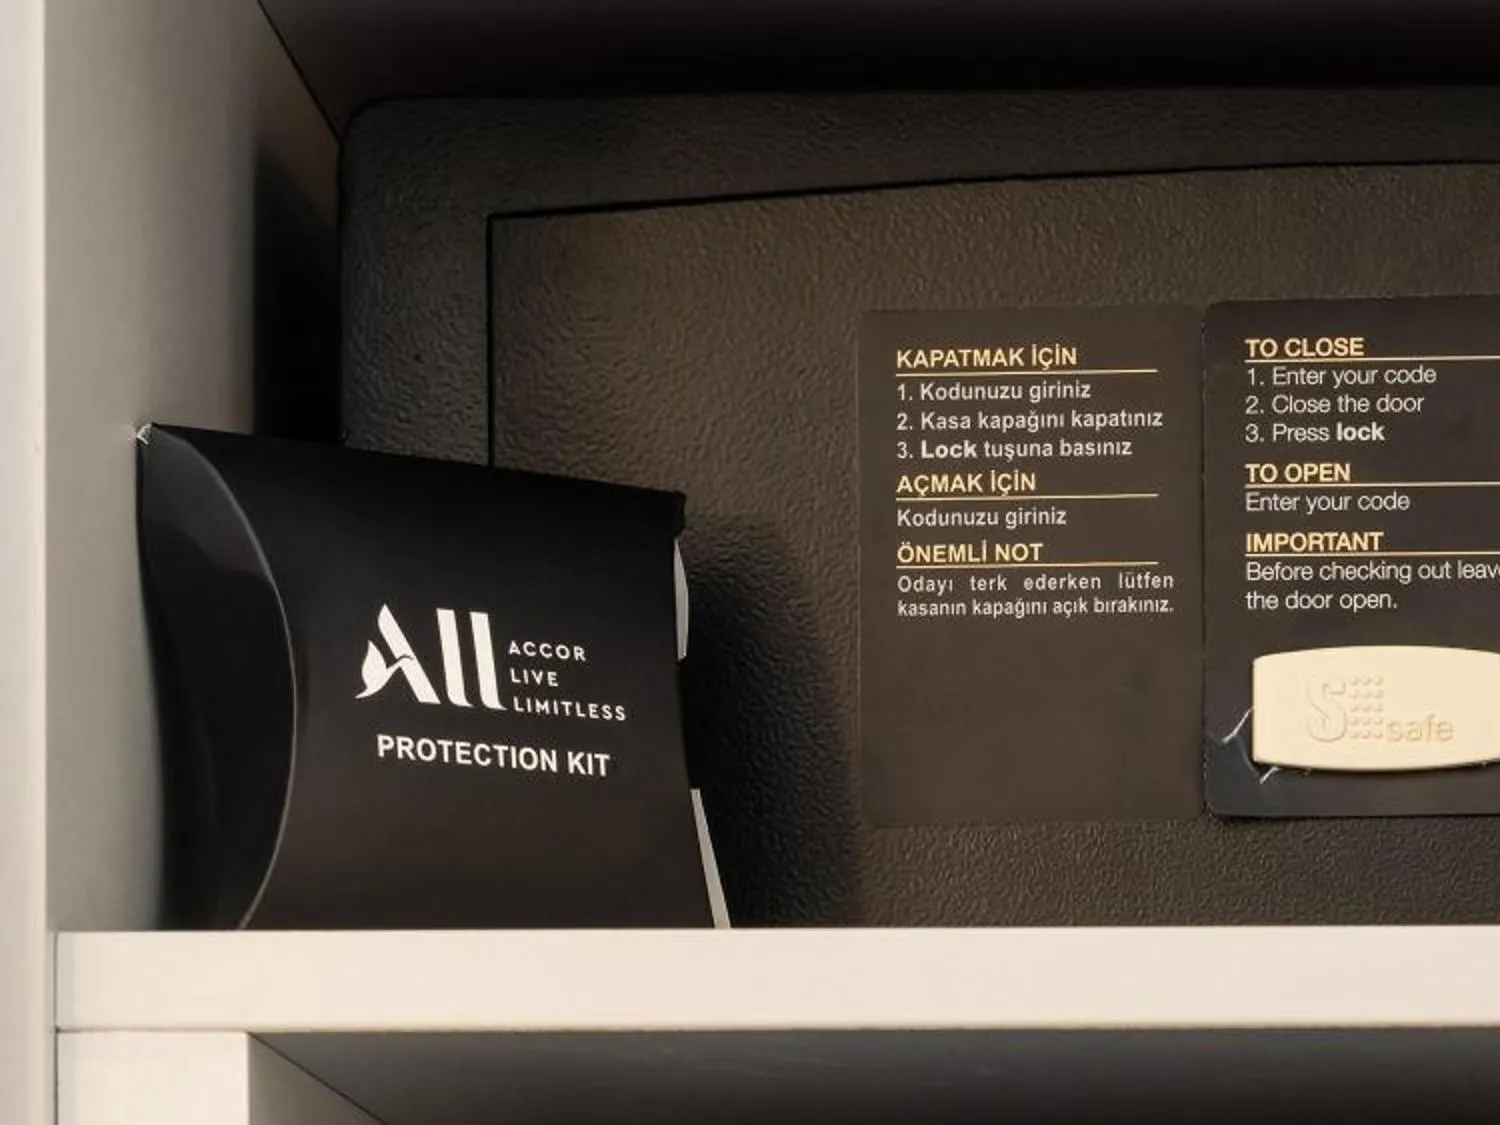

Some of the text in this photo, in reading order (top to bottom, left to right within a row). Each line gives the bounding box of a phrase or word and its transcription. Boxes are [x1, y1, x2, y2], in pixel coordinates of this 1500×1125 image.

[897, 343, 1077, 370] KAPATMAK İÇİN
[1245, 337, 1365, 358] TO CLOSE
[1247, 365, 1436, 388] 1. Enter your code
[898, 381, 1091, 402] 1. Kodunuzu giriniz
[1246, 394, 1424, 414] 2. Close the door
[897, 410, 1163, 432] 2. Kasa kapağını kapatınız
[1246, 422, 1385, 442] 3. Press lock
[897, 439, 1133, 461] 3. Lock tuşuna basınız
[897, 470, 1036, 496] AÇMAK İÇİN
[1245, 463, 1351, 482] TO OPEN
[1246, 492, 1410, 514] Enter your code
[897, 507, 1067, 529] Kodunuzu giriniz
[1246, 531, 1384, 551] IMPORTANT
[897, 541, 1043, 563] ÖNEMLİ NOT
[1246, 562, 1314, 581] Before
[1320, 562, 1411, 583] checking
[1418, 564, 1450, 579] out
[897, 572, 1174, 595] Odayı terk ederken lütfen
[898, 597, 1174, 618] kasanın kapağını açık bırakınız.
[1246, 591, 1397, 612] the door open.
[508, 640, 586, 661] ACCOR
[510, 668, 559, 687] LIVE
[513, 696, 626, 721] LIMITLESS
[377, 734, 610, 777] PROTECTION KIT
